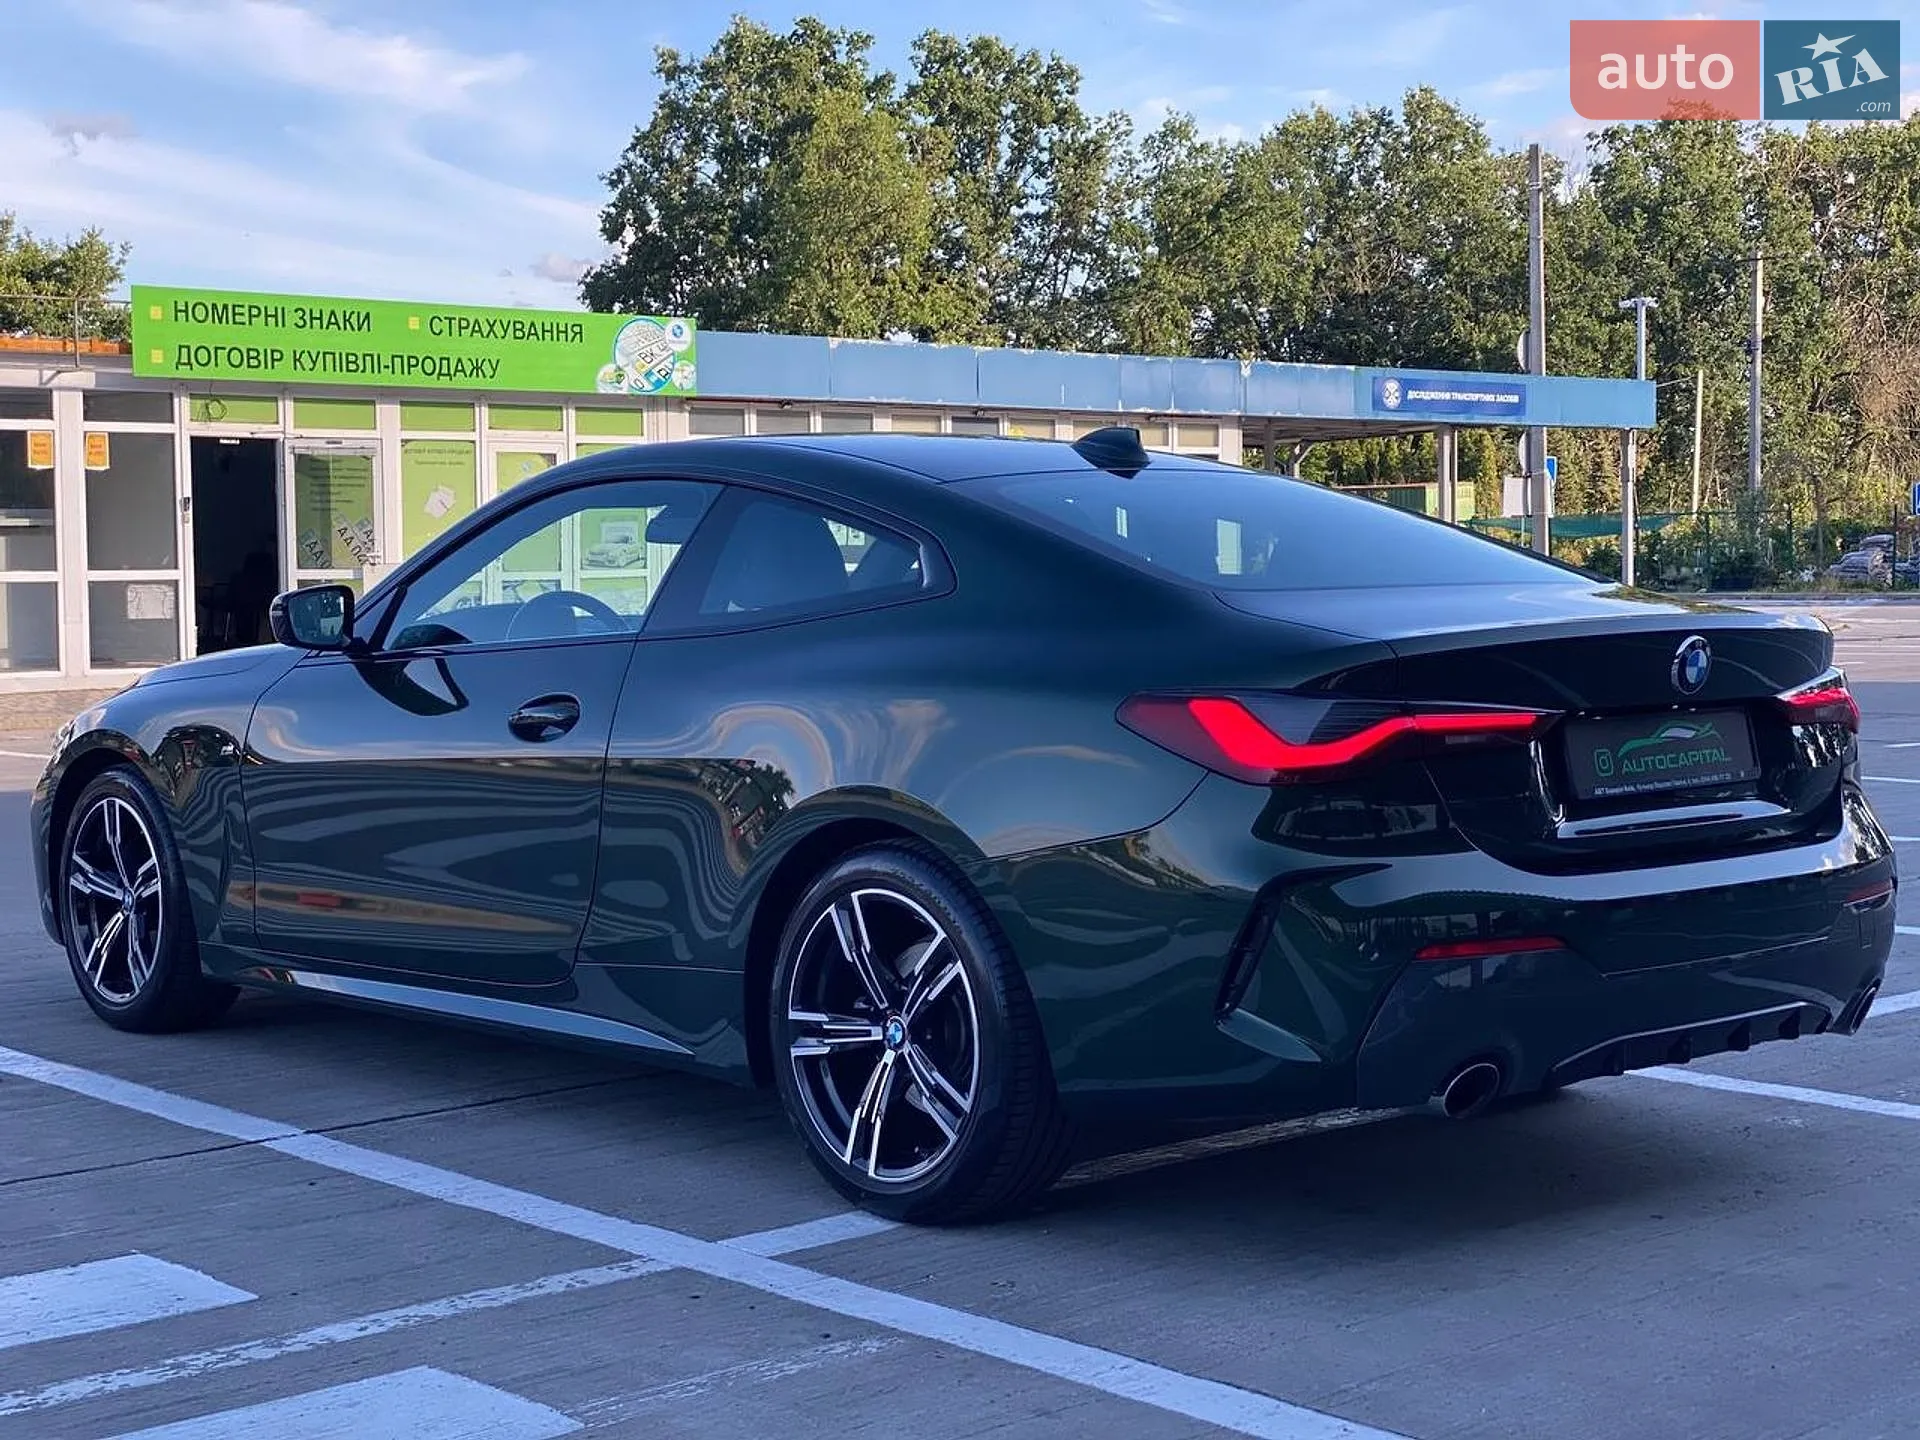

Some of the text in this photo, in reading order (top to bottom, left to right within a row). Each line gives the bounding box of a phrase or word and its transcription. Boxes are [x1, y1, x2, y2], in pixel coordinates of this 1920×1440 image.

[173, 300, 372, 332] НОМЕРНІ ЗНАКИ
[429, 315, 584, 343] СТРАХУВАННЯ
[175, 344, 501, 381] ДОГОВІР КУПІВЛІ-ПРОДАЖУ
[1621, 747, 1733, 775] AUTOCAPITAL
